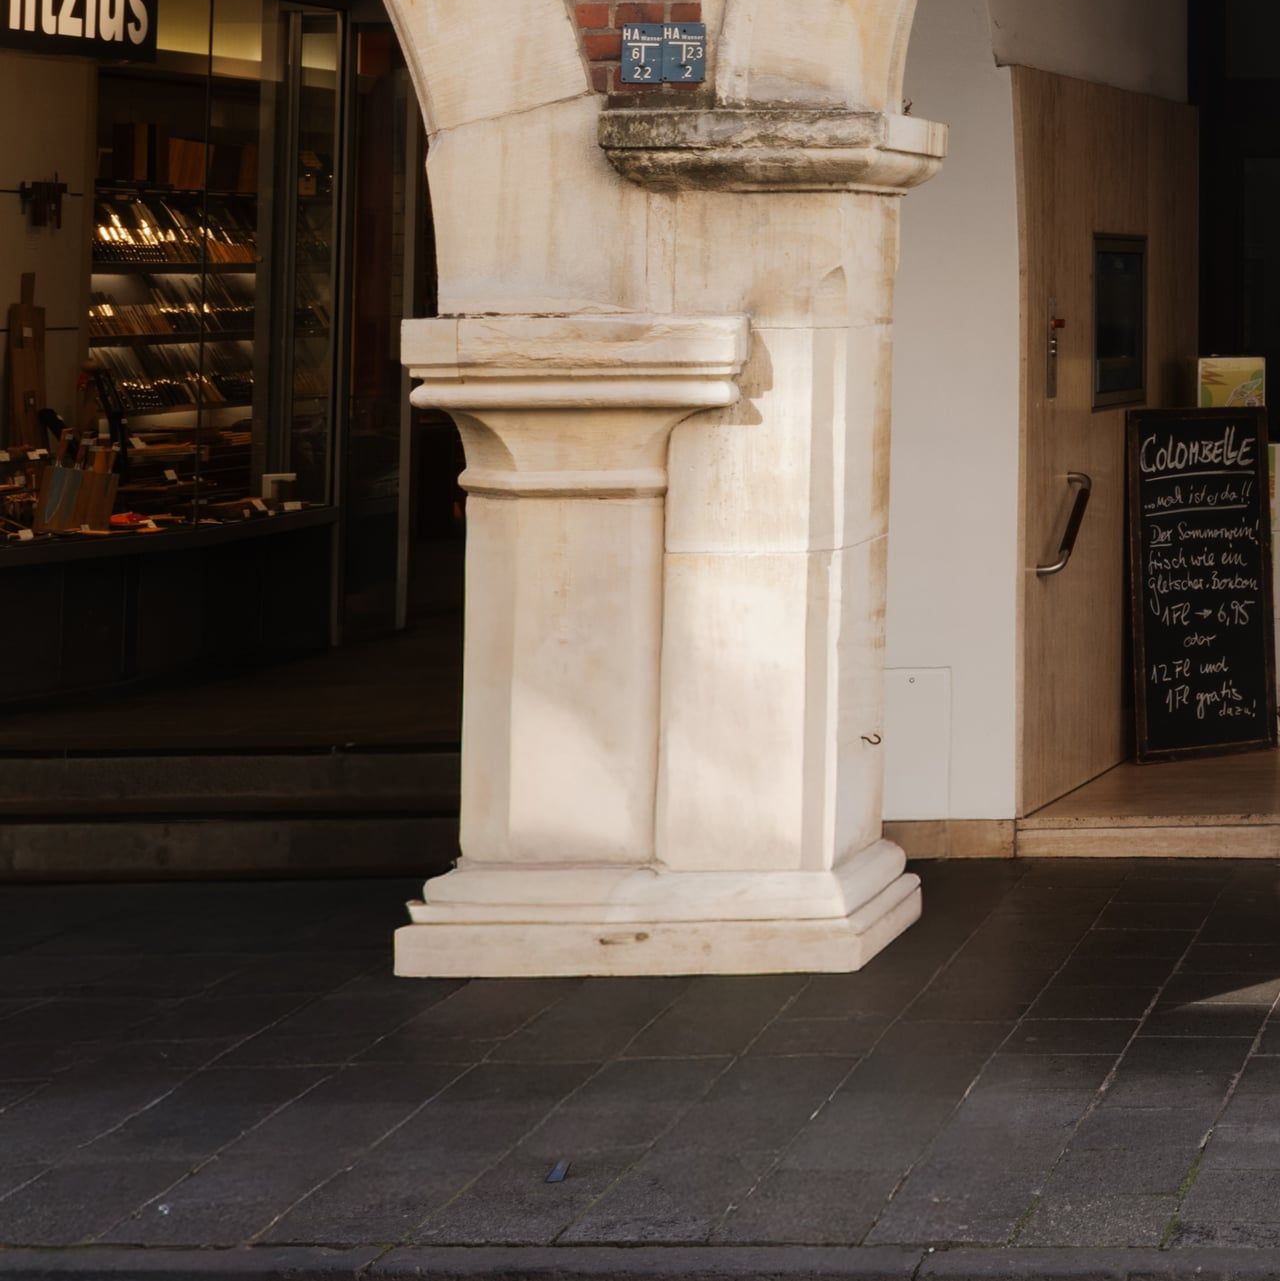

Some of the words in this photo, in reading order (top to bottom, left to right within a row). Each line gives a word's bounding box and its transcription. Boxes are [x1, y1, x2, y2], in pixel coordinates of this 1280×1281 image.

[623, 28, 639, 40] HA
[664, 27, 680, 39] HA
[1191, 546, 1215, 567] wie
[1221, 543, 1248, 567] ein
[1217, 600, 1256, 626] 6,95
